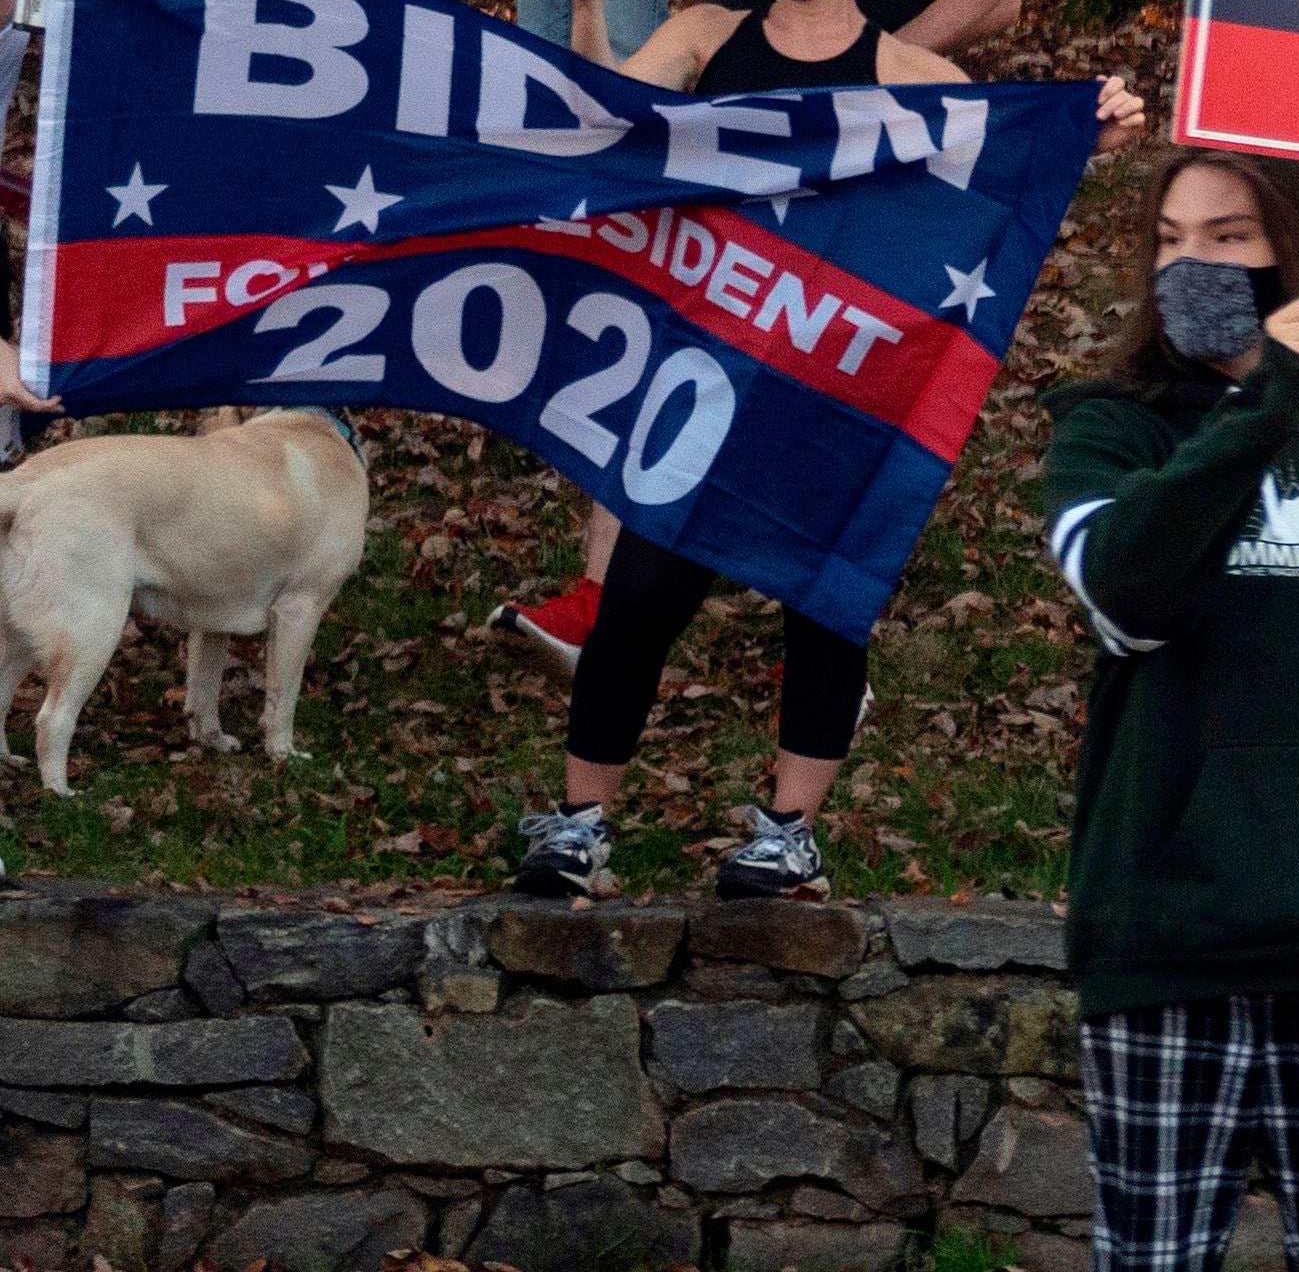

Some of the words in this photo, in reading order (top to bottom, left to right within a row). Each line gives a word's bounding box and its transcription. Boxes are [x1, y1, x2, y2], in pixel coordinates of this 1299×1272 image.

[163, 259, 330, 327] FO
[534, 206, 905, 377] SIDENT
[245, 262, 737, 506] 2020
